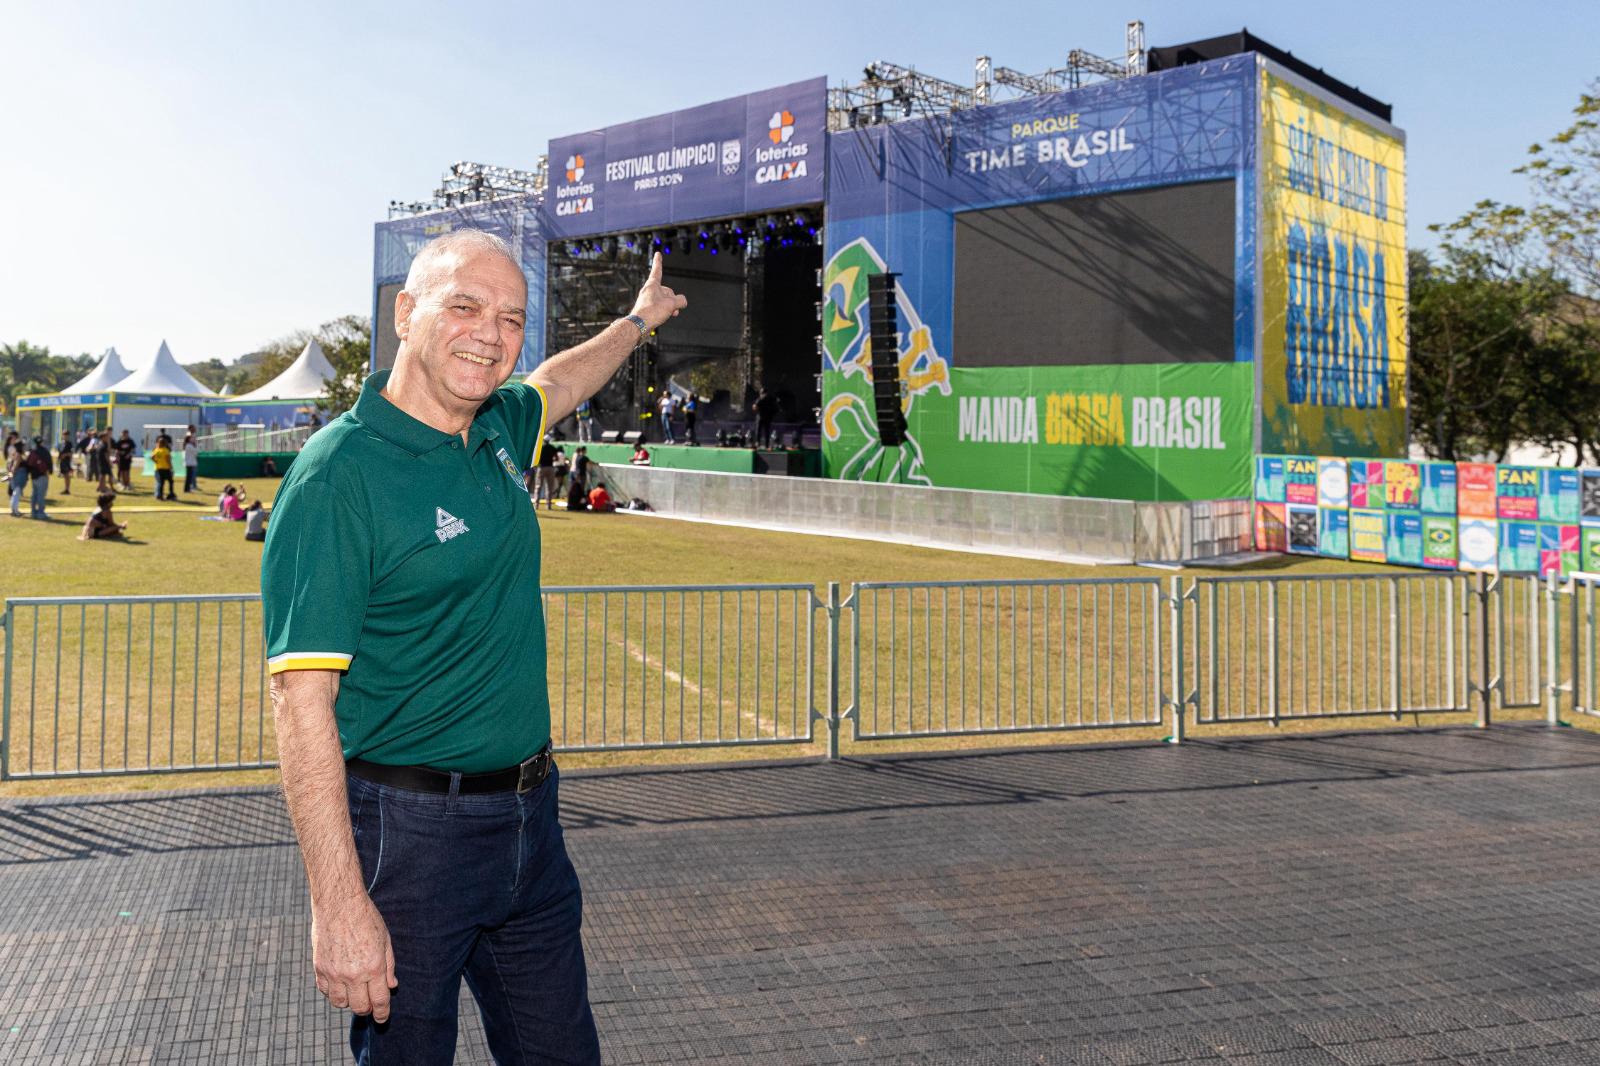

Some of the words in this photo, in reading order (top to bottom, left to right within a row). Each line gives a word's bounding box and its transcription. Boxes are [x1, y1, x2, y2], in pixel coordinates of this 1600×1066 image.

[1011, 114, 1080, 138] PARQUE
[606, 159, 655, 182] FESTIVAL
[658, 142, 715, 172] OLÍMPICO
[756, 143, 808, 164] loterias
[966, 143, 1026, 174] TIME
[1038, 129, 1134, 168] BRASIL
[635, 177, 657, 192] PARIS
[659, 173, 683, 187] 2024
[756, 160, 807, 184] CAIXA
[557, 182, 594, 198] loterias
[556, 197, 593, 216] CAIXA
[1287, 220, 1390, 409] BRASA
[959, 397, 1038, 443] MANDA
[1045, 391, 1124, 447] BRASA
[1132, 396, 1225, 449] BRASIL
[1287, 460, 1315, 474] FAN
[1499, 469, 1536, 485] FAN
